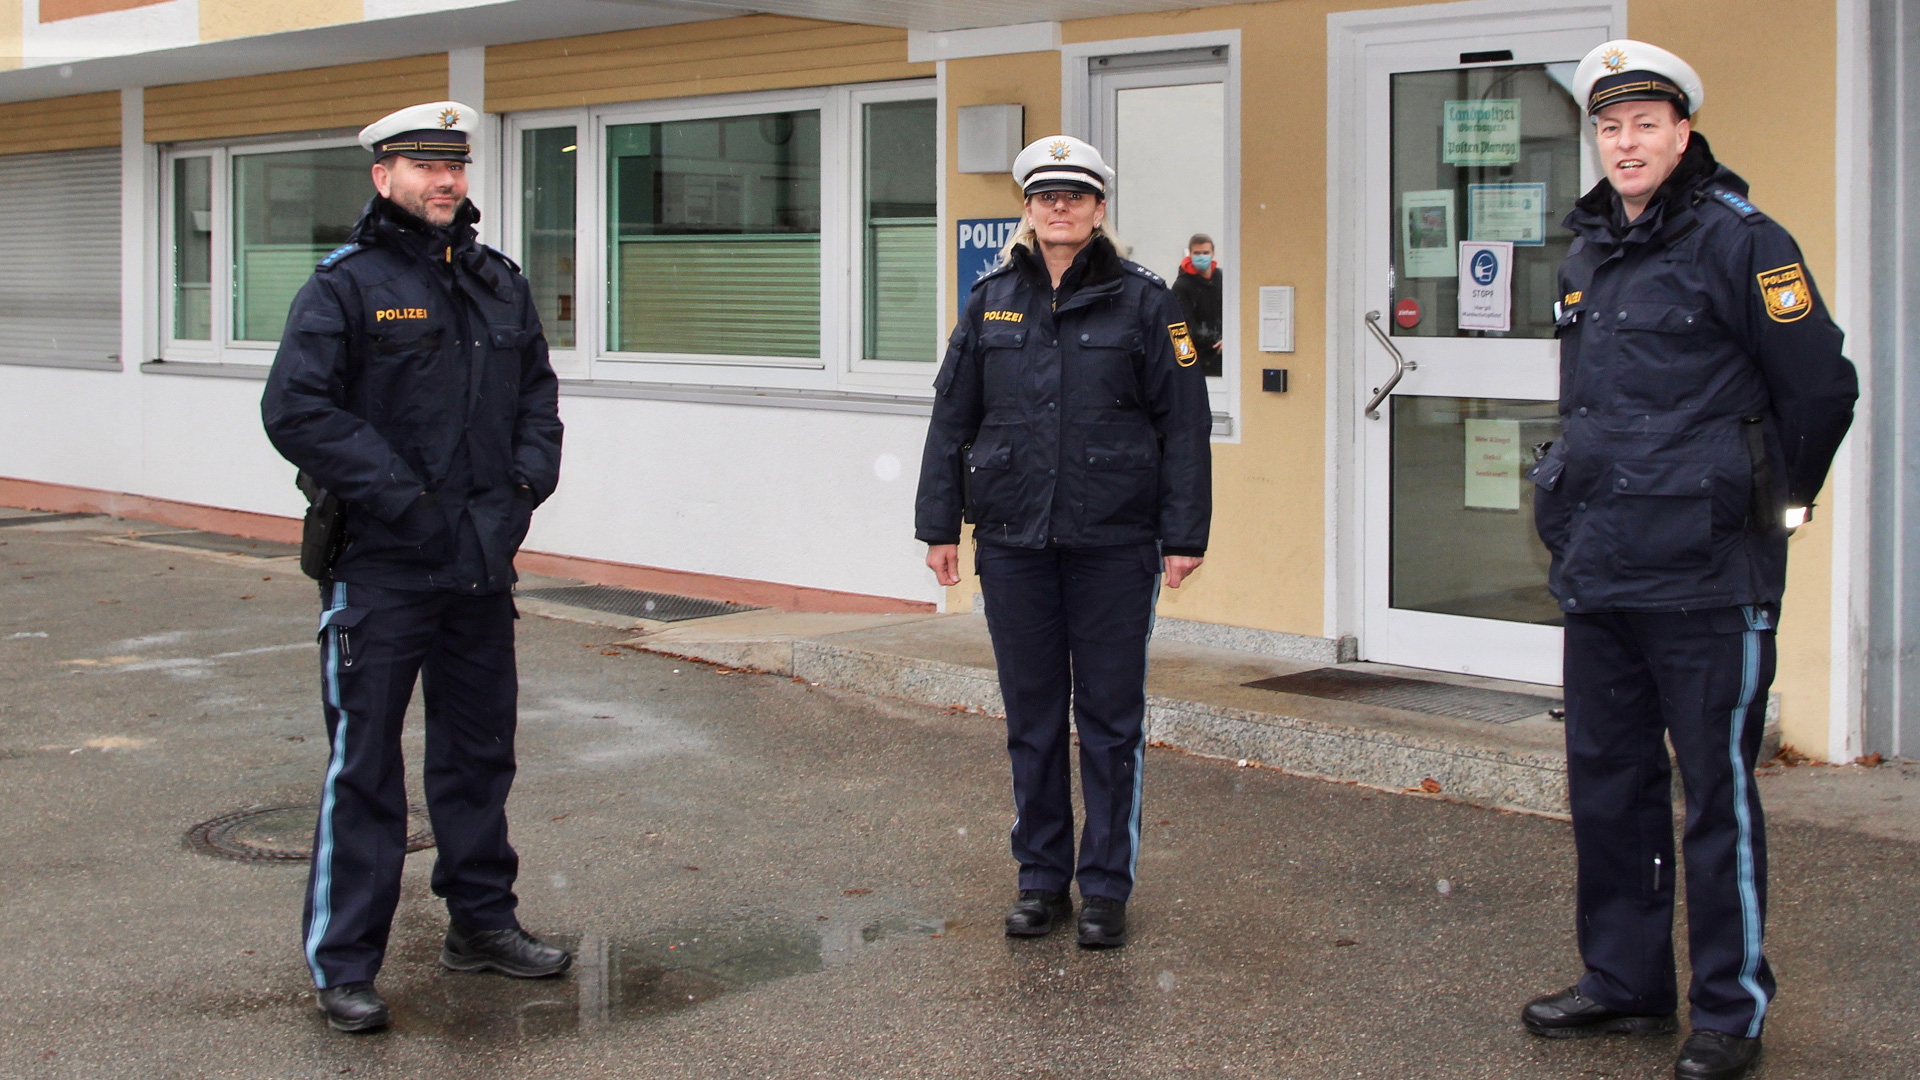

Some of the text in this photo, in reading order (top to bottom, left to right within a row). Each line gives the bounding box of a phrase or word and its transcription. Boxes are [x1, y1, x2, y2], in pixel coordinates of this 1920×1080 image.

[1449, 106, 1515, 123] Landpolizei
[959, 222, 1019, 249] POLIZ
[376, 308, 428, 322] POLIZEI
[983, 310, 1024, 323] POLIZEI
